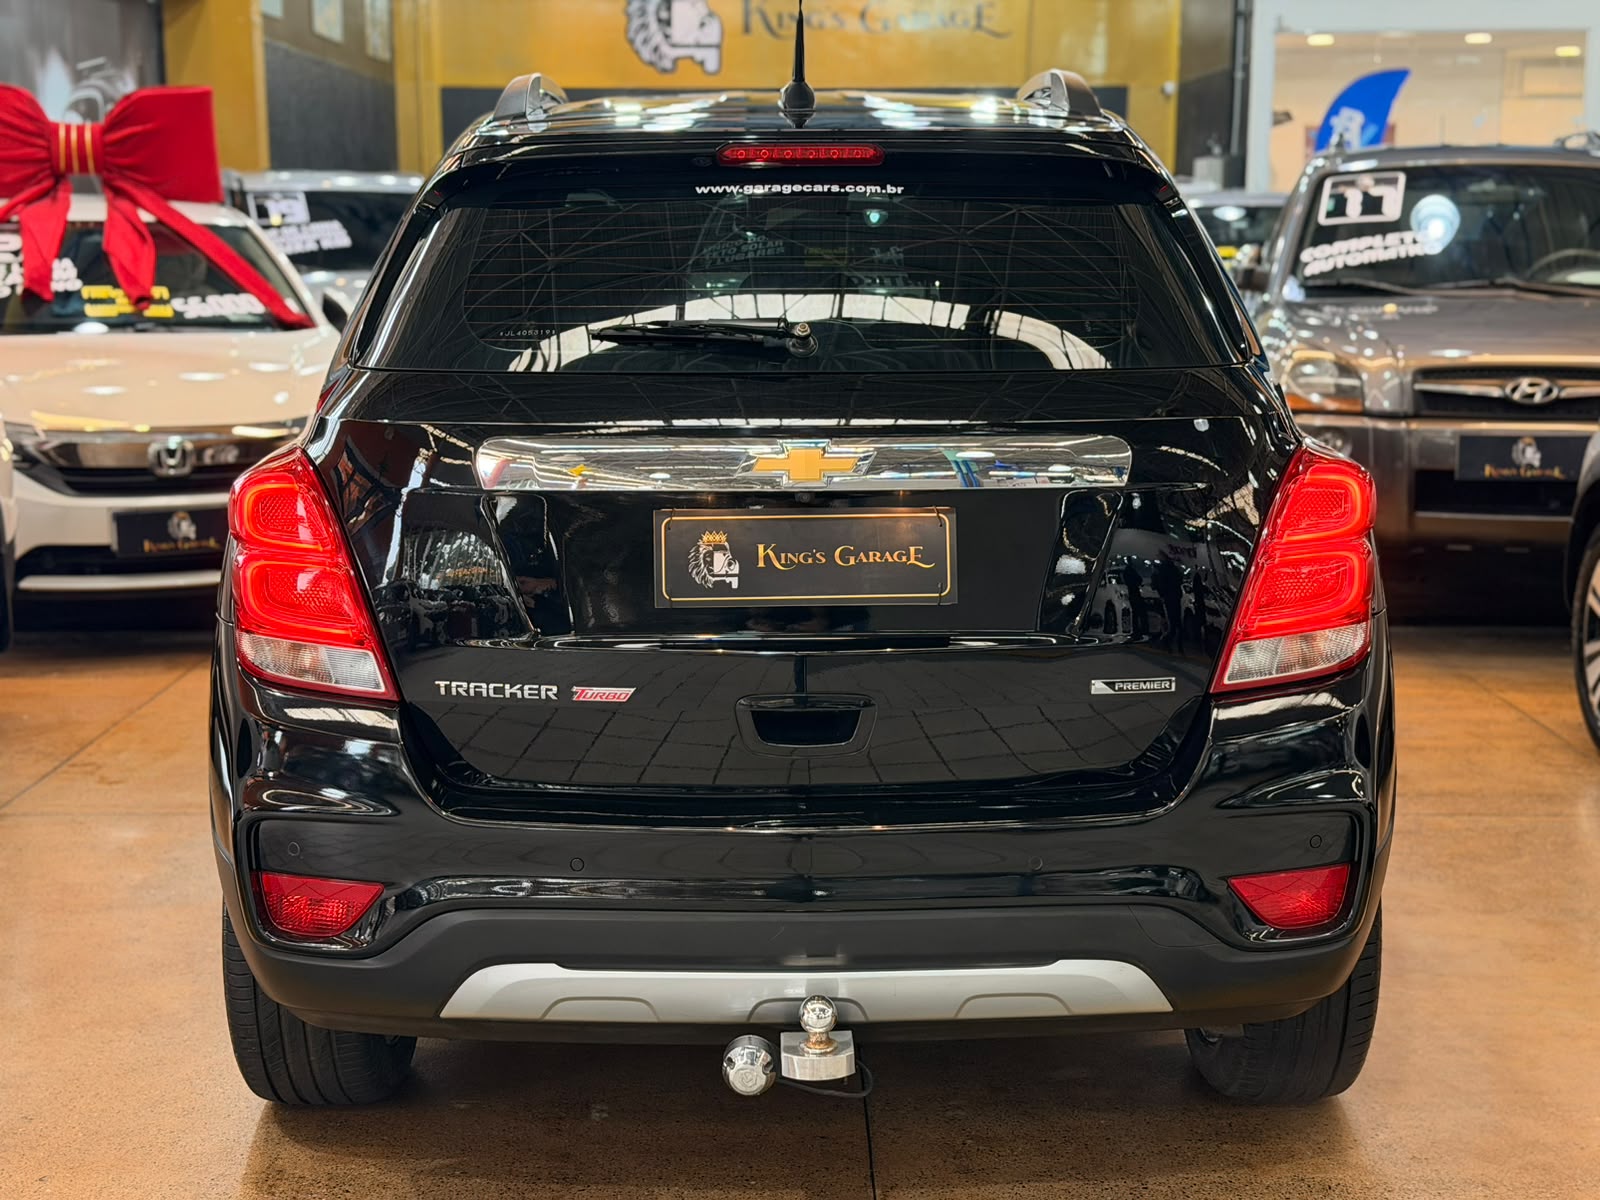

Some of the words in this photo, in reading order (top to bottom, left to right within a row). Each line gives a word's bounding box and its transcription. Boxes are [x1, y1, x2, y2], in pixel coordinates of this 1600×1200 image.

[695, 183, 905, 195] www.garagecars.com.br
[756, 543, 826, 571] KING'S
[834, 545, 936, 569] GARAGE
[434, 680, 559, 700] TRACKER
[1114, 680, 1171, 691] PREMIER
[573, 687, 631, 702] TURBO
